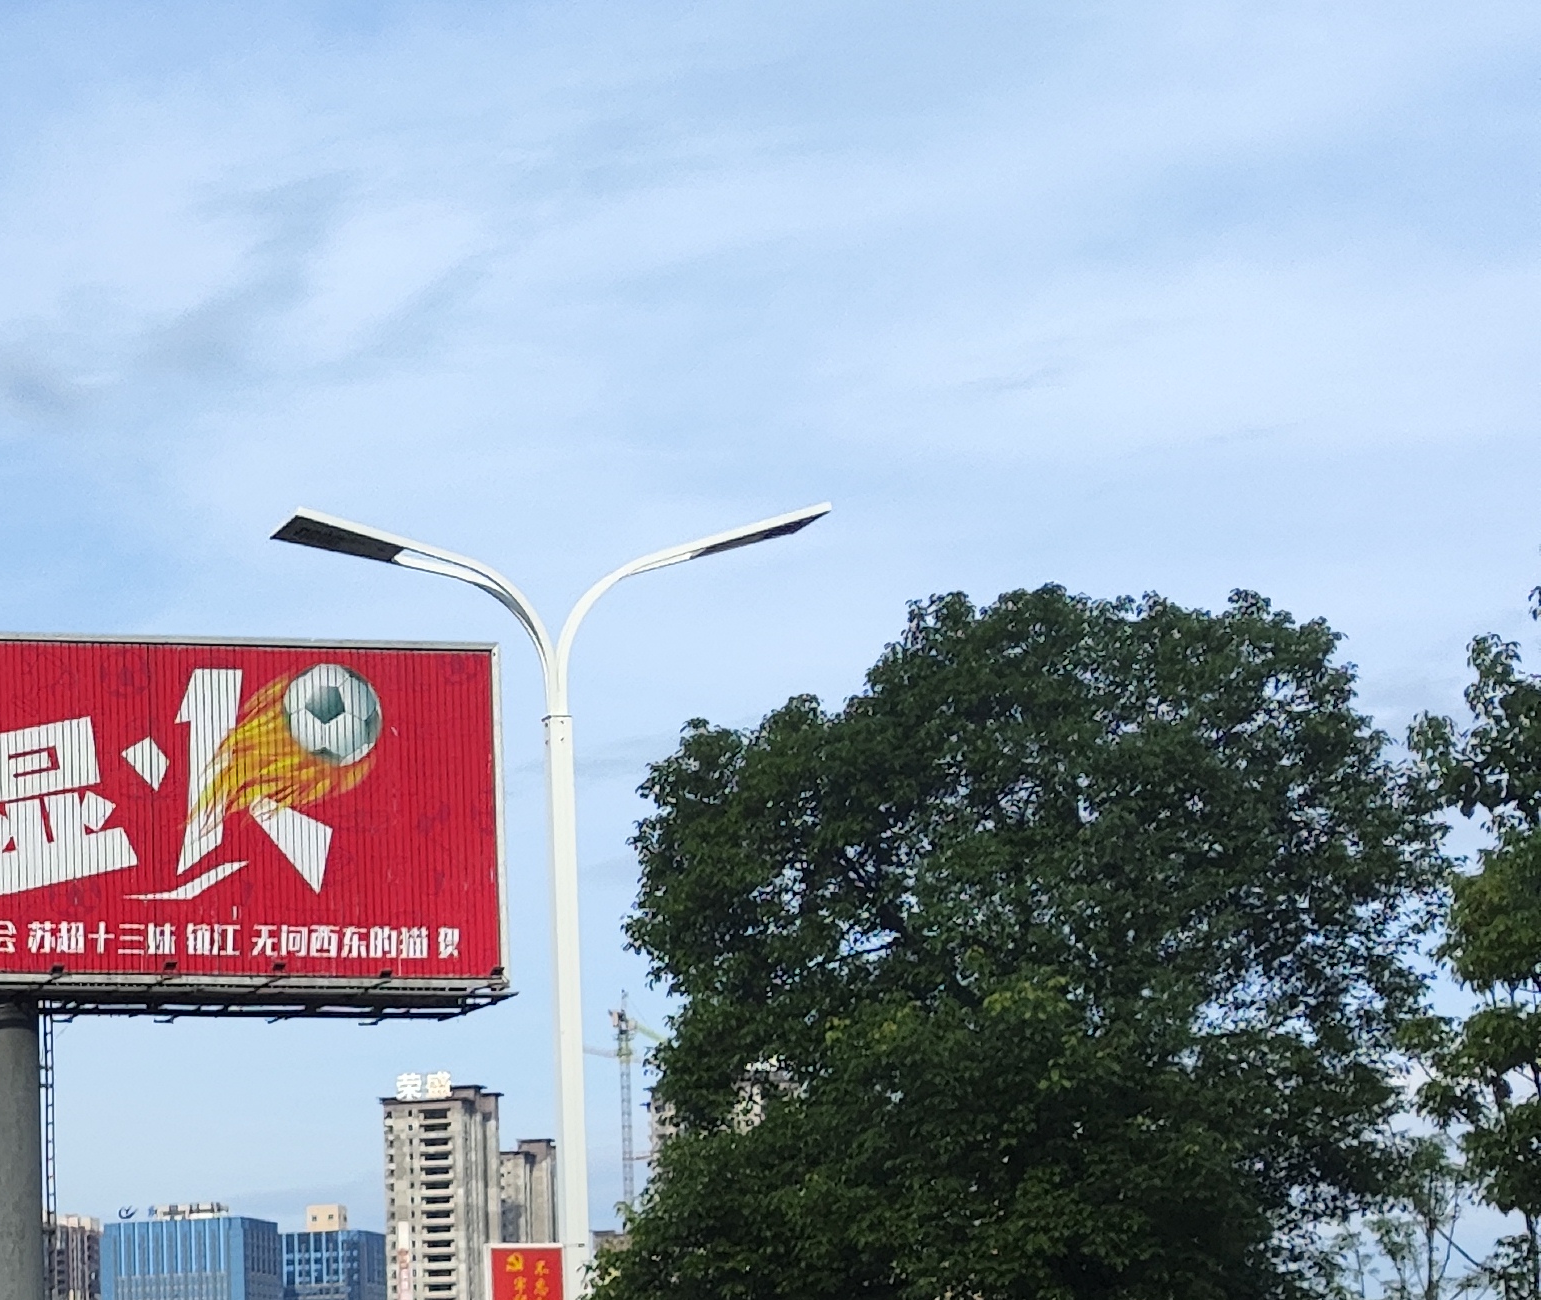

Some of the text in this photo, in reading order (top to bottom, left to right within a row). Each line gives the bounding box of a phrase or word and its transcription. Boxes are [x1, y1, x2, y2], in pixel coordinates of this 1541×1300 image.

[27, 920, 176, 955] 苏超十三妹
[186, 922, 241, 956] 镇江
[437, 926, 460, 959] 贺
